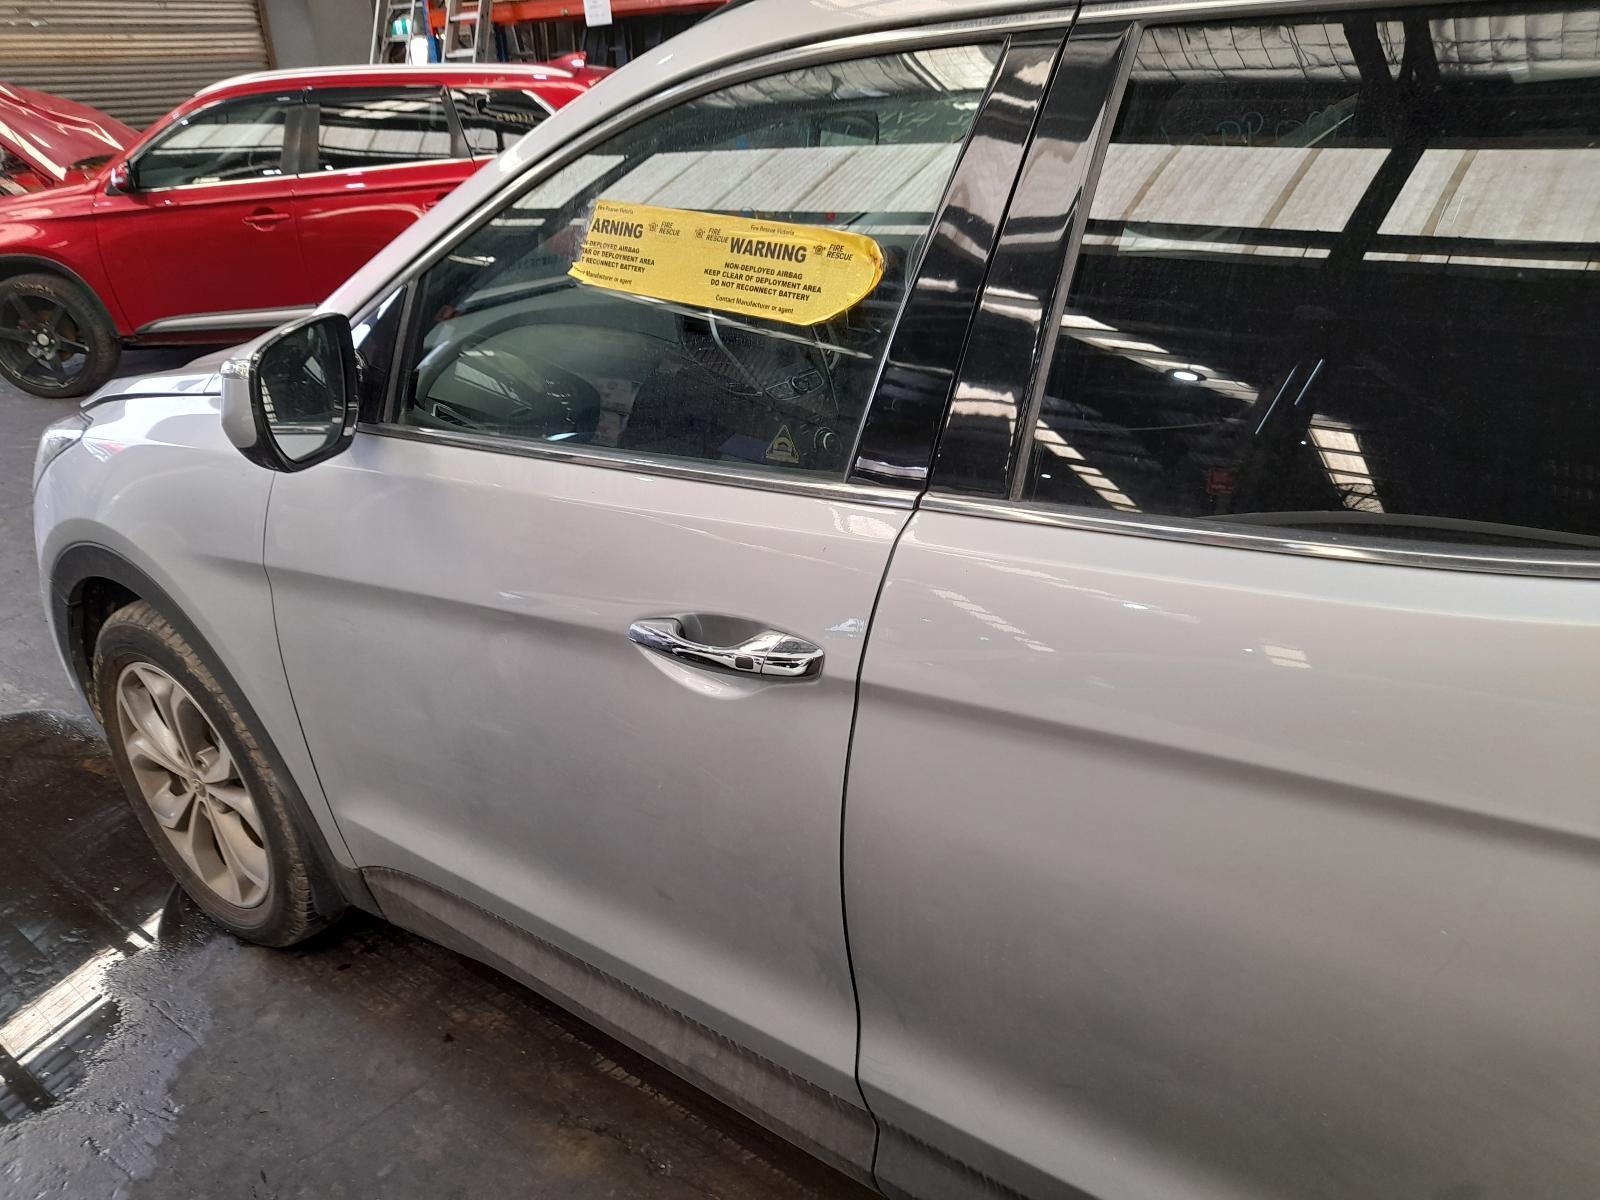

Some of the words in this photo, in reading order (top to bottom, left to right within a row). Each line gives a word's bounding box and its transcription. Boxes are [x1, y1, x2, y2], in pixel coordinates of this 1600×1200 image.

[658, 228, 681, 236] RESCUE
[619, 245, 640, 254] AIRBAG
[730, 237, 808, 263] WARNING
[829, 243, 844, 253] FIRE
[601, 251, 638, 263] DEPLOYMENT
[640, 258, 655, 266] AREA
[826, 251, 853, 262] RESCUE
[586, 258, 619, 269] RECONNECT
[620, 264, 646, 273] BATTERY
[724, 262, 775, 276] NON-DEPLOYED
[776, 270, 803, 281] AIRBAG
[704, 268, 721, 277] KEEP
[722, 271, 744, 281] CLEAR
[745, 274, 754, 282] OF
[755, 275, 801, 291] DEPLOYMENT
[802, 284, 822, 293] AREA
[721, 280, 734, 289] NOT
[736, 282, 777, 296] RECONNECT
[778, 289, 810, 302] BATTERY
[715, 294, 734, 304] Contact
[736, 297, 770, 310] Manufacturer
[778, 306, 794, 314] agent
